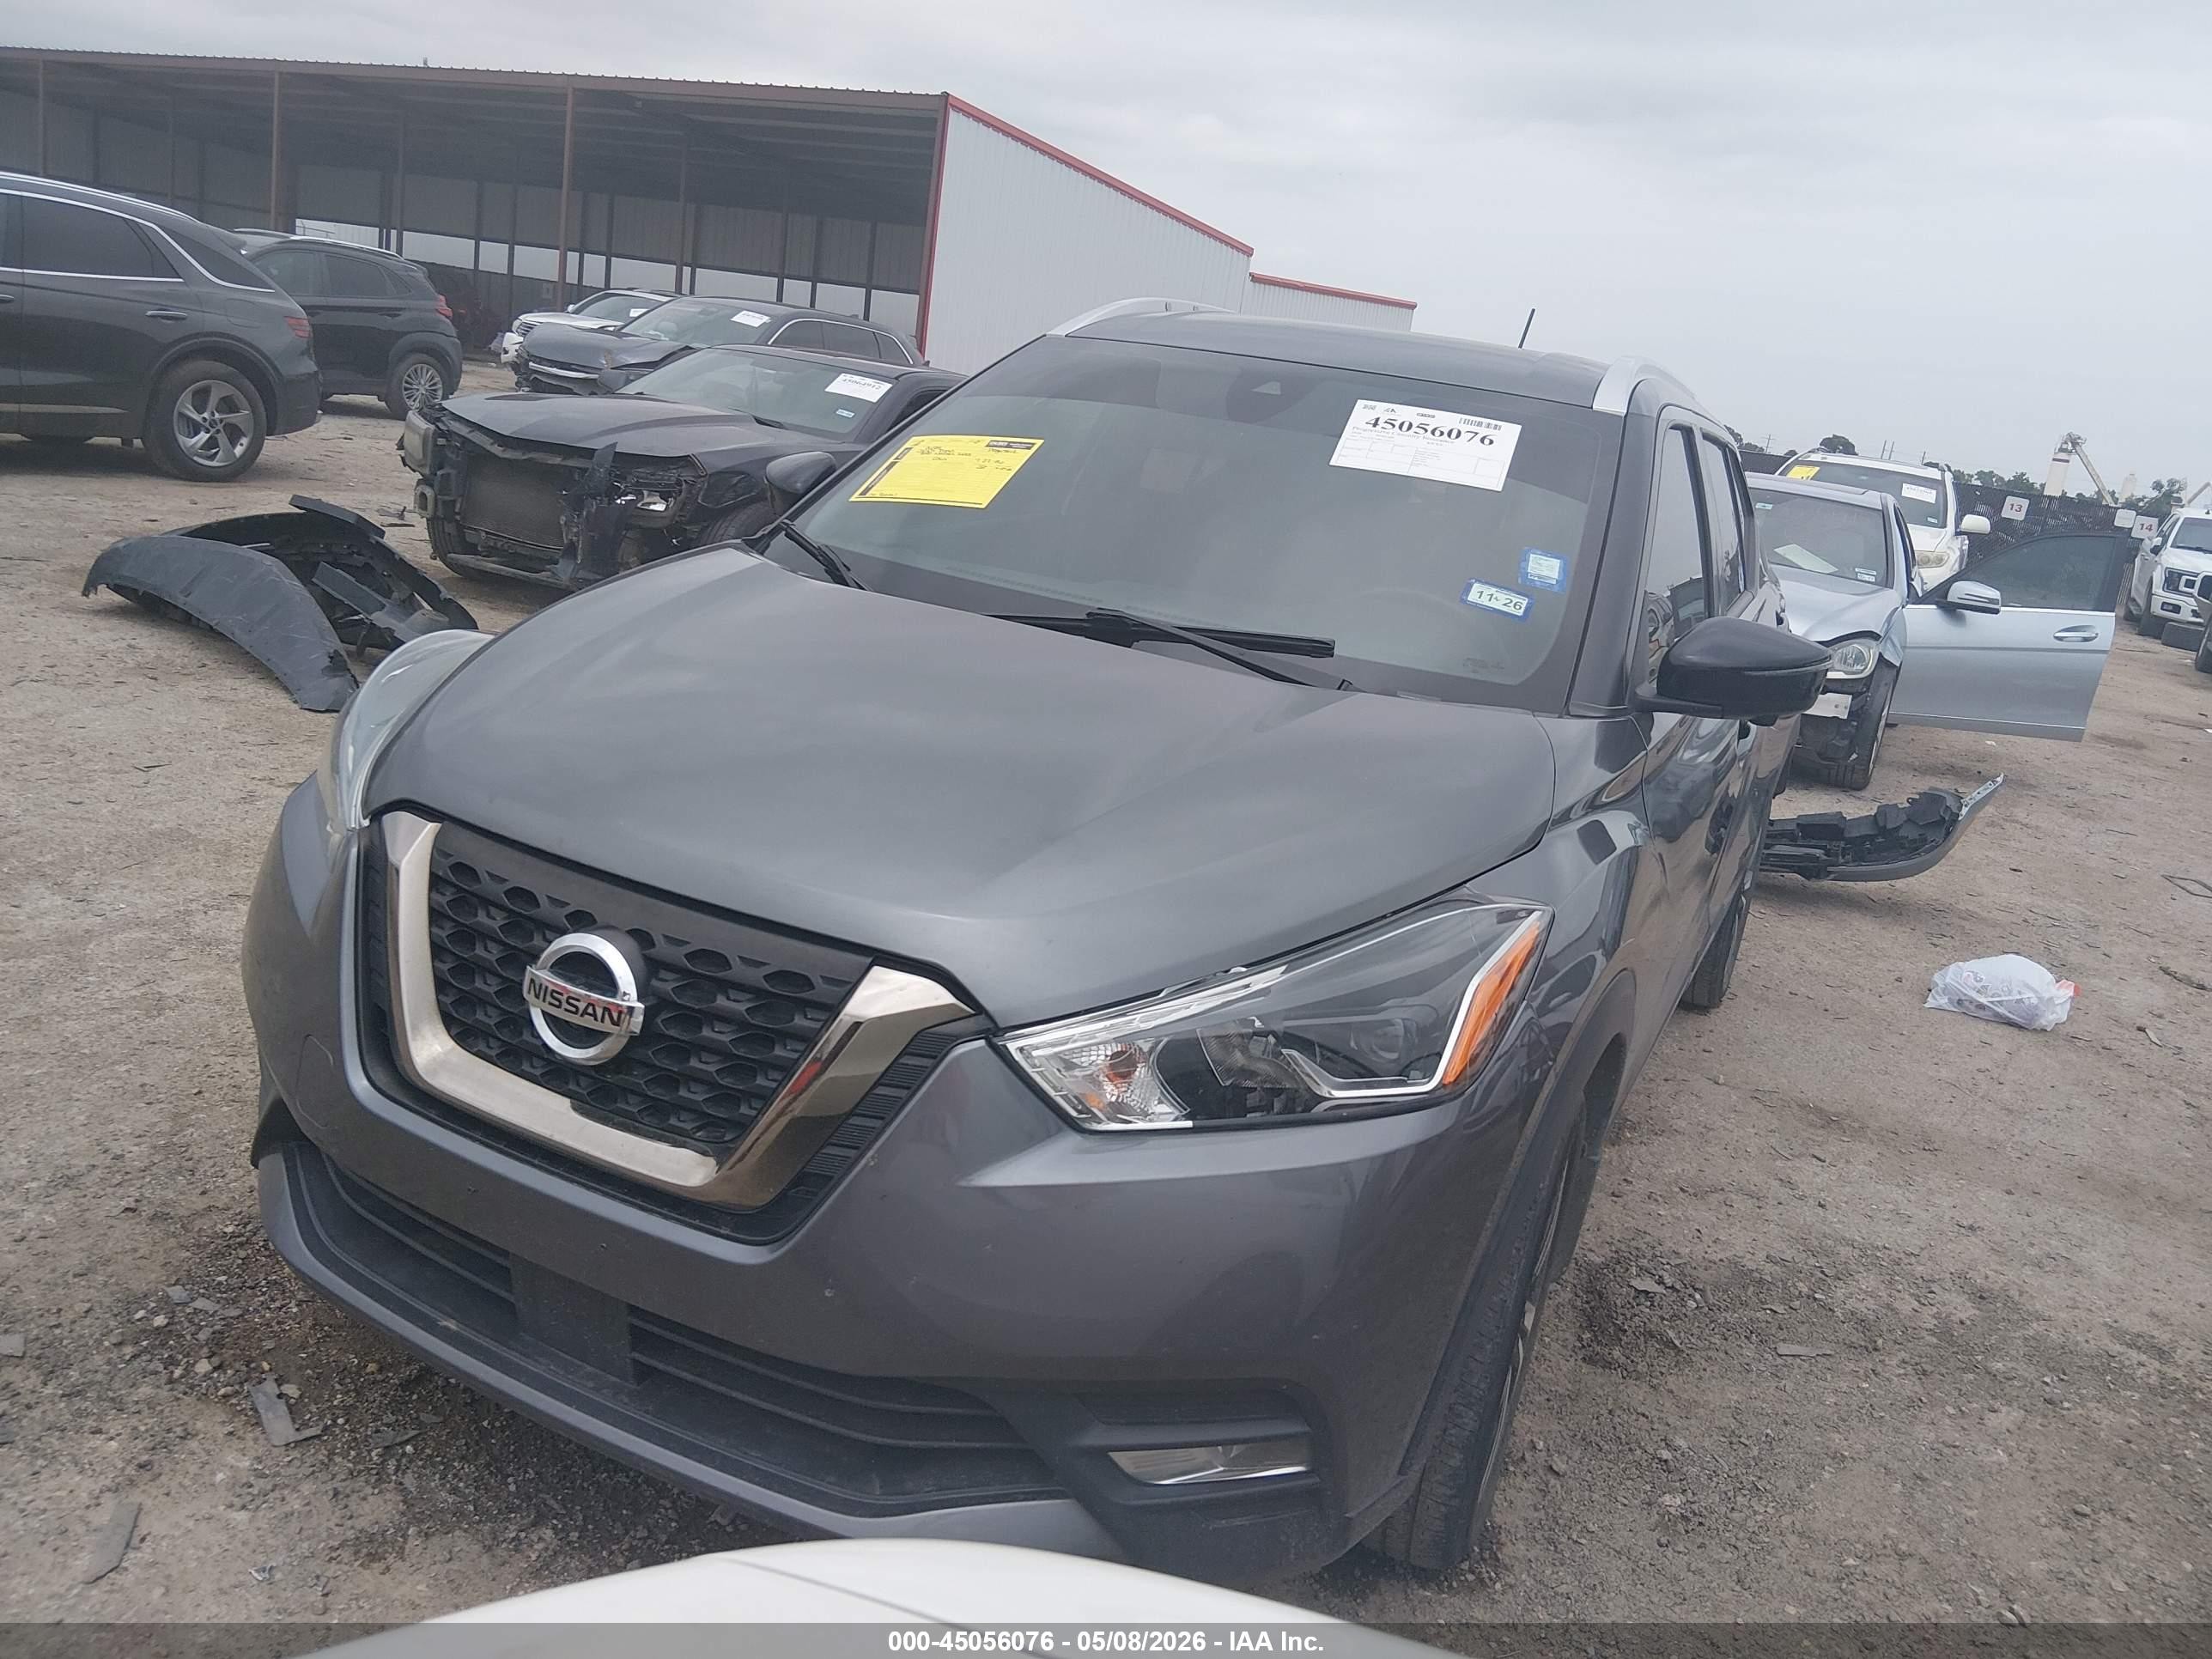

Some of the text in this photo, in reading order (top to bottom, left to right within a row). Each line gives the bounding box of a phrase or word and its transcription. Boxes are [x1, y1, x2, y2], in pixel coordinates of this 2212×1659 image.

[1364, 416, 1495, 446] 45056076
[2008, 502, 2023, 514] 13
[2139, 522, 2154, 532] 14
[527, 977, 623, 1028] NISSAN
